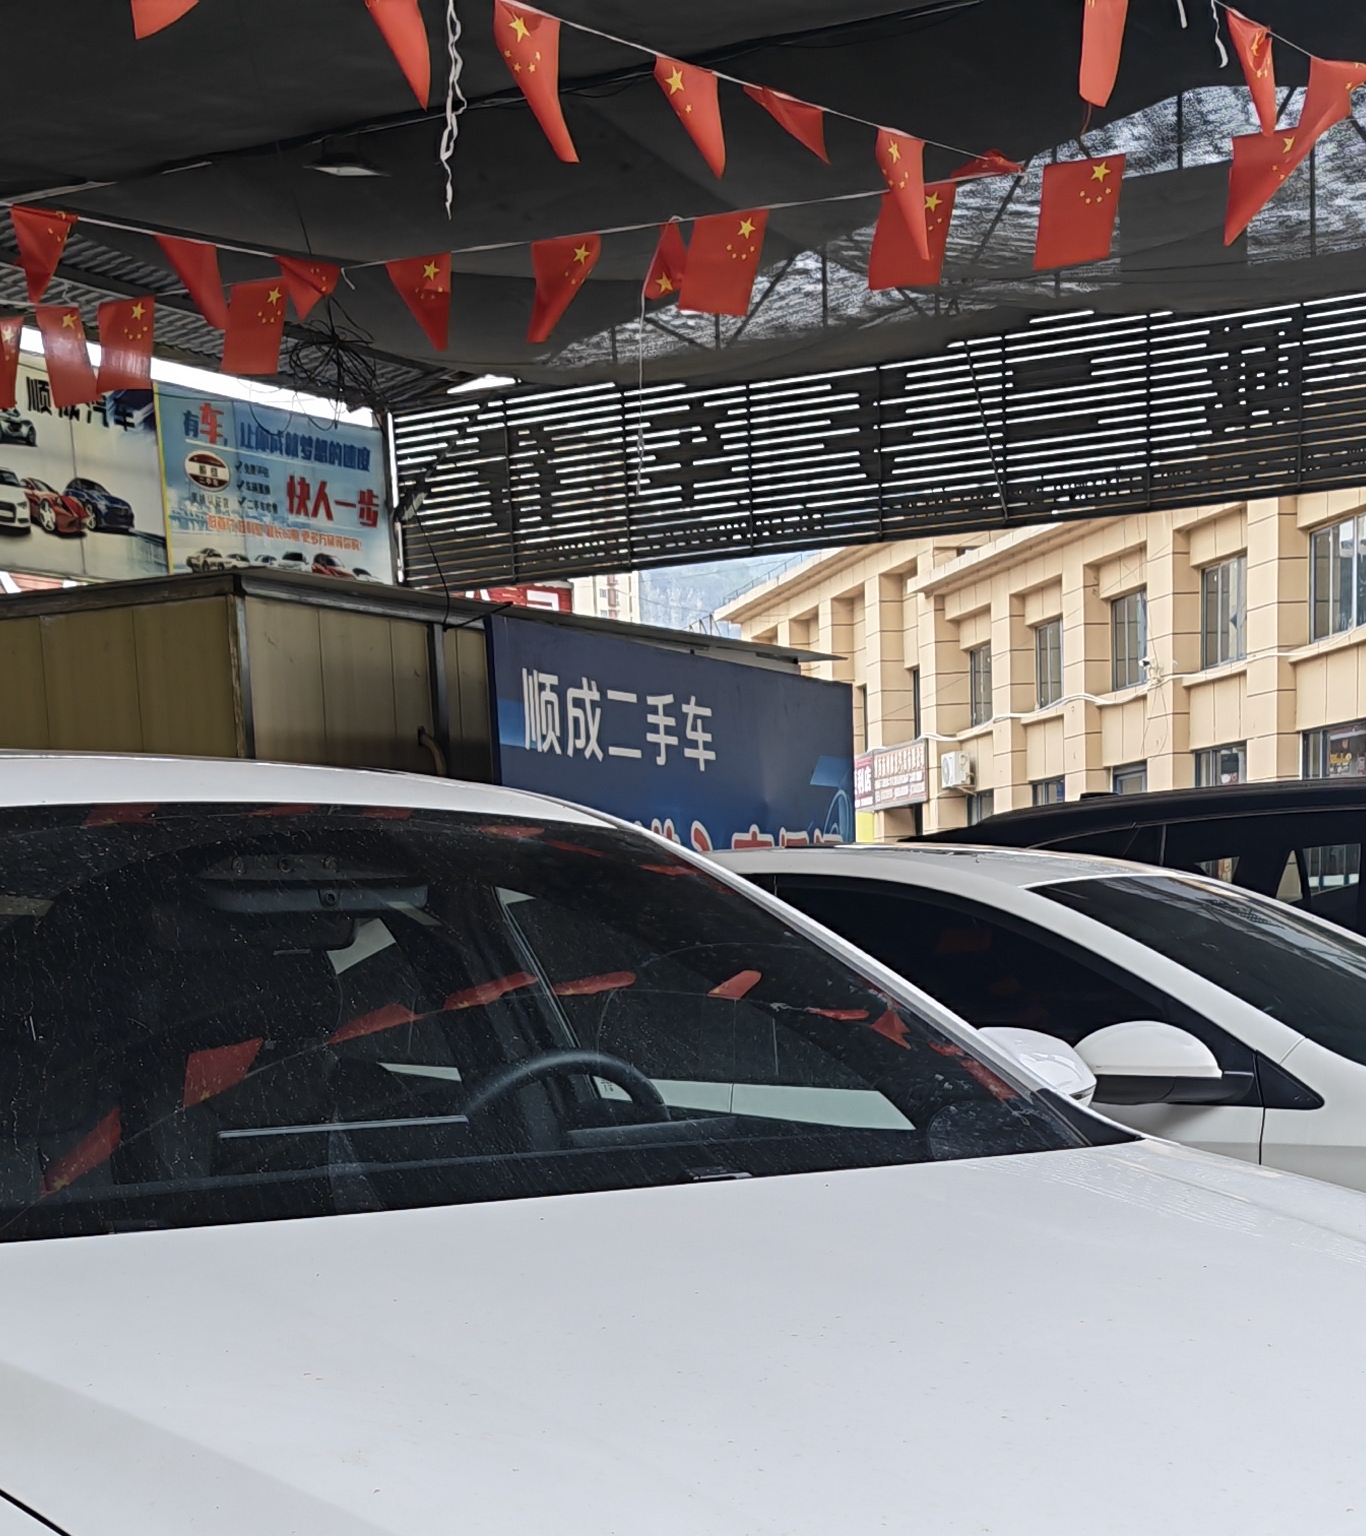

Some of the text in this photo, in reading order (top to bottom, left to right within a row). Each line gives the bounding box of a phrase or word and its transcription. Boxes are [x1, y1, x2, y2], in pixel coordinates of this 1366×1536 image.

[286, 474, 379, 528] 快人一步
[521, 667, 717, 772] 顺成二手车
